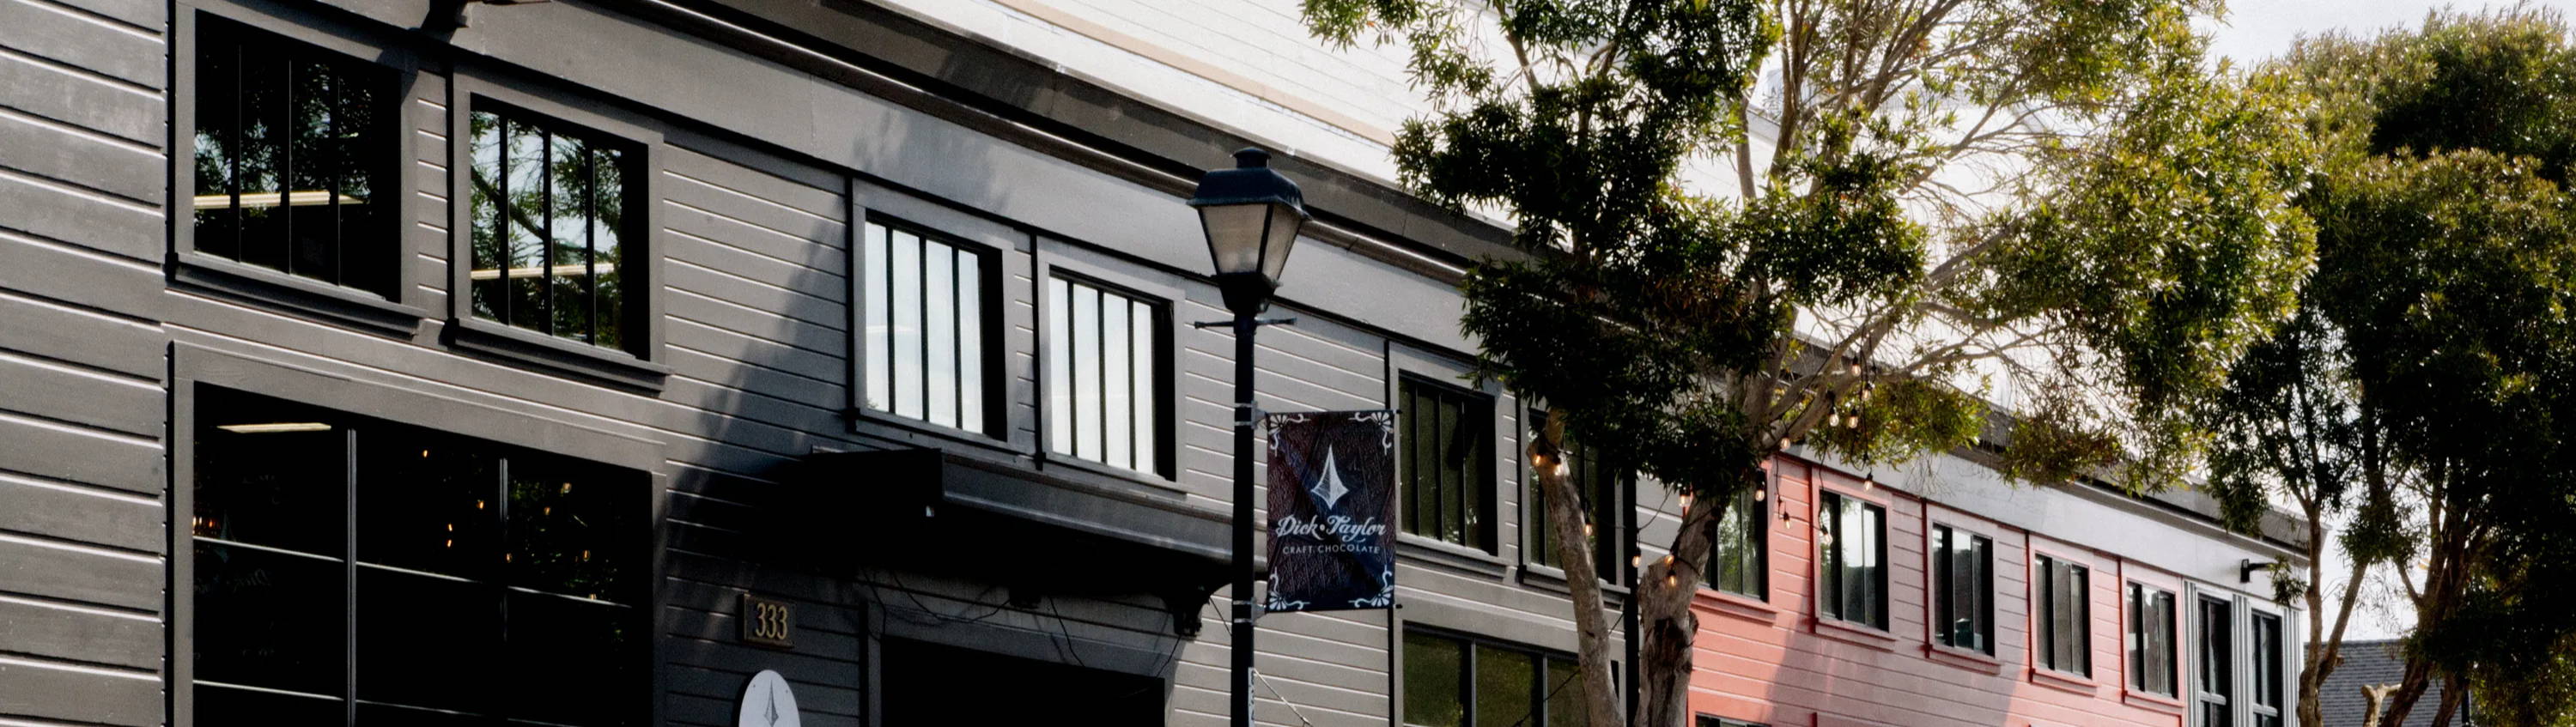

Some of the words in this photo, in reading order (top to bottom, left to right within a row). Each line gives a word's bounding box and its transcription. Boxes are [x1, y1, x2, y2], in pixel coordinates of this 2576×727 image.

[1275, 514, 1324, 540] Dick
[1326, 515, 1387, 542] Taylor
[1283, 546, 1314, 554] CRAFT
[1317, 544, 1380, 554] CHOCOLATE
[756, 602, 788, 640] 333
